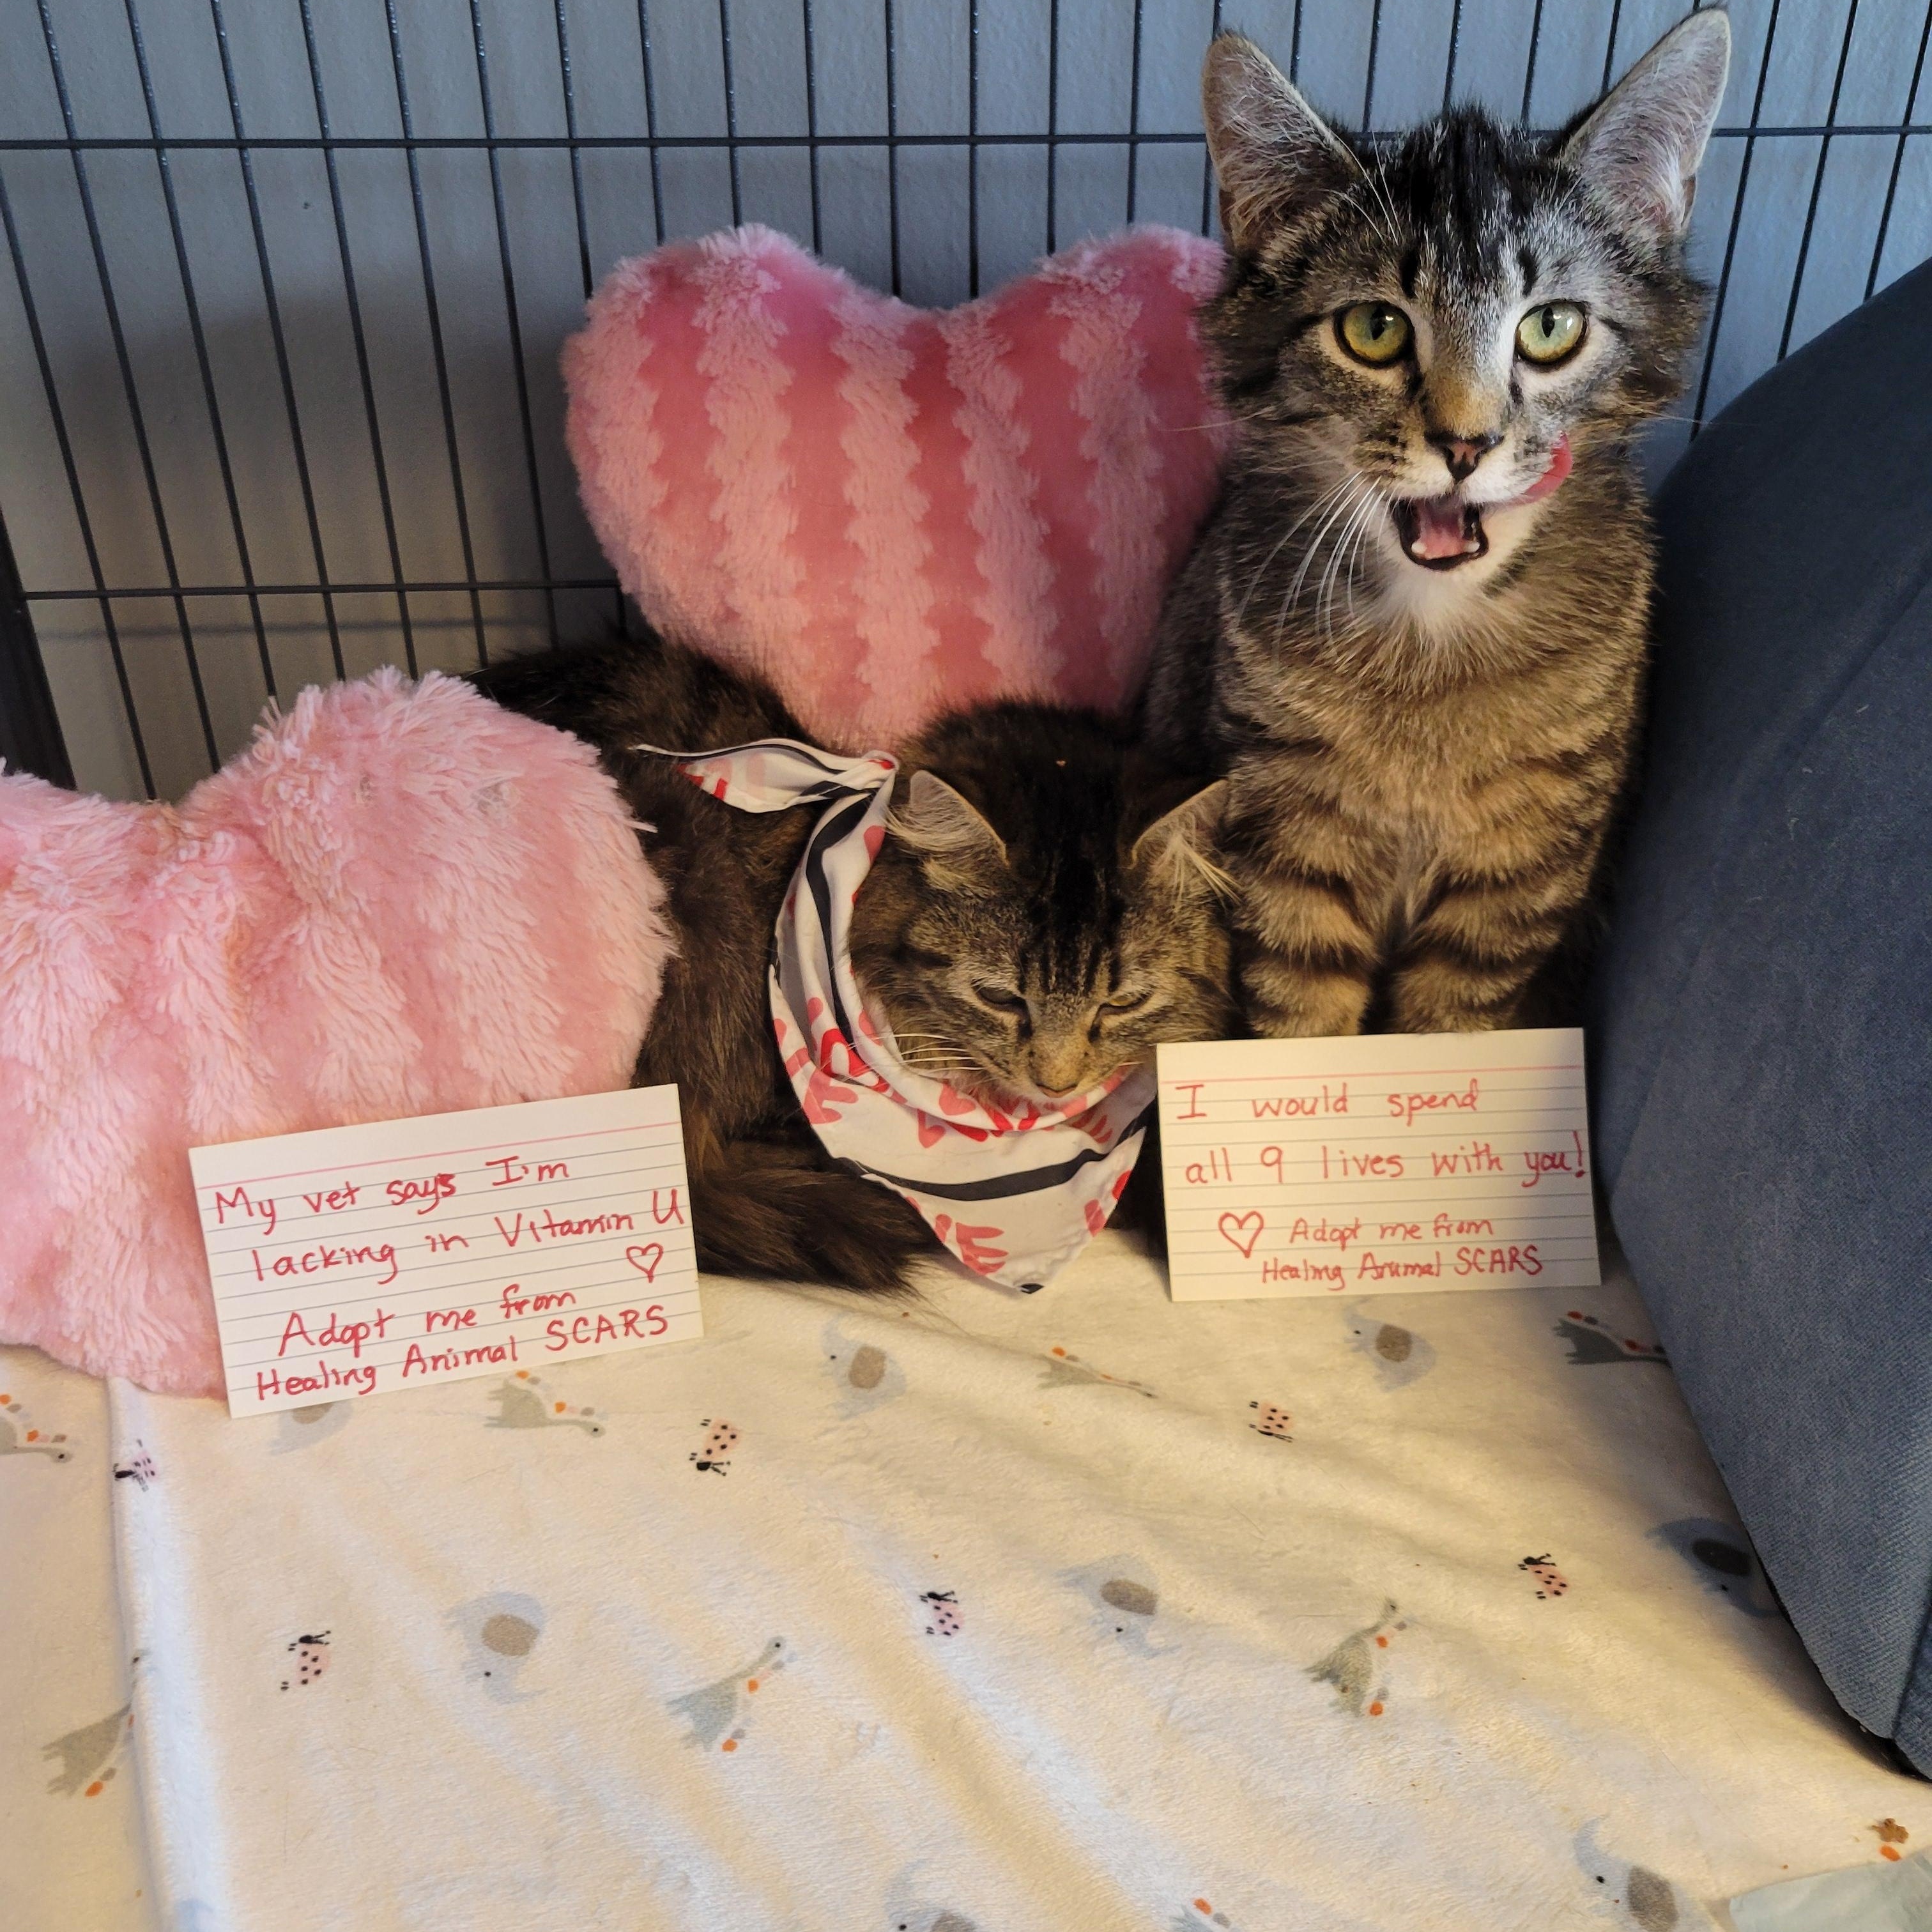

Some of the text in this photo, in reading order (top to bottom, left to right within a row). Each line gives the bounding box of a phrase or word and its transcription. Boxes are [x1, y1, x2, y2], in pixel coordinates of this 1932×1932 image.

[1174, 1077, 1479, 1126] I would spend
[1184, 1131, 1585, 1188] all 9 lives with you!
[214, 1154, 570, 1237] My vet says I'm
[251, 1187, 685, 1286] lacking in Vitamin U
[1291, 1212, 1494, 1252] Adopt me from
[1262, 1259, 1347, 1291] Healing
[1455, 1244, 1544, 1277] SCARS
[256, 1303, 669, 1402] Healing Animal SCARS
[277, 1282, 577, 1359] Adopt me from
